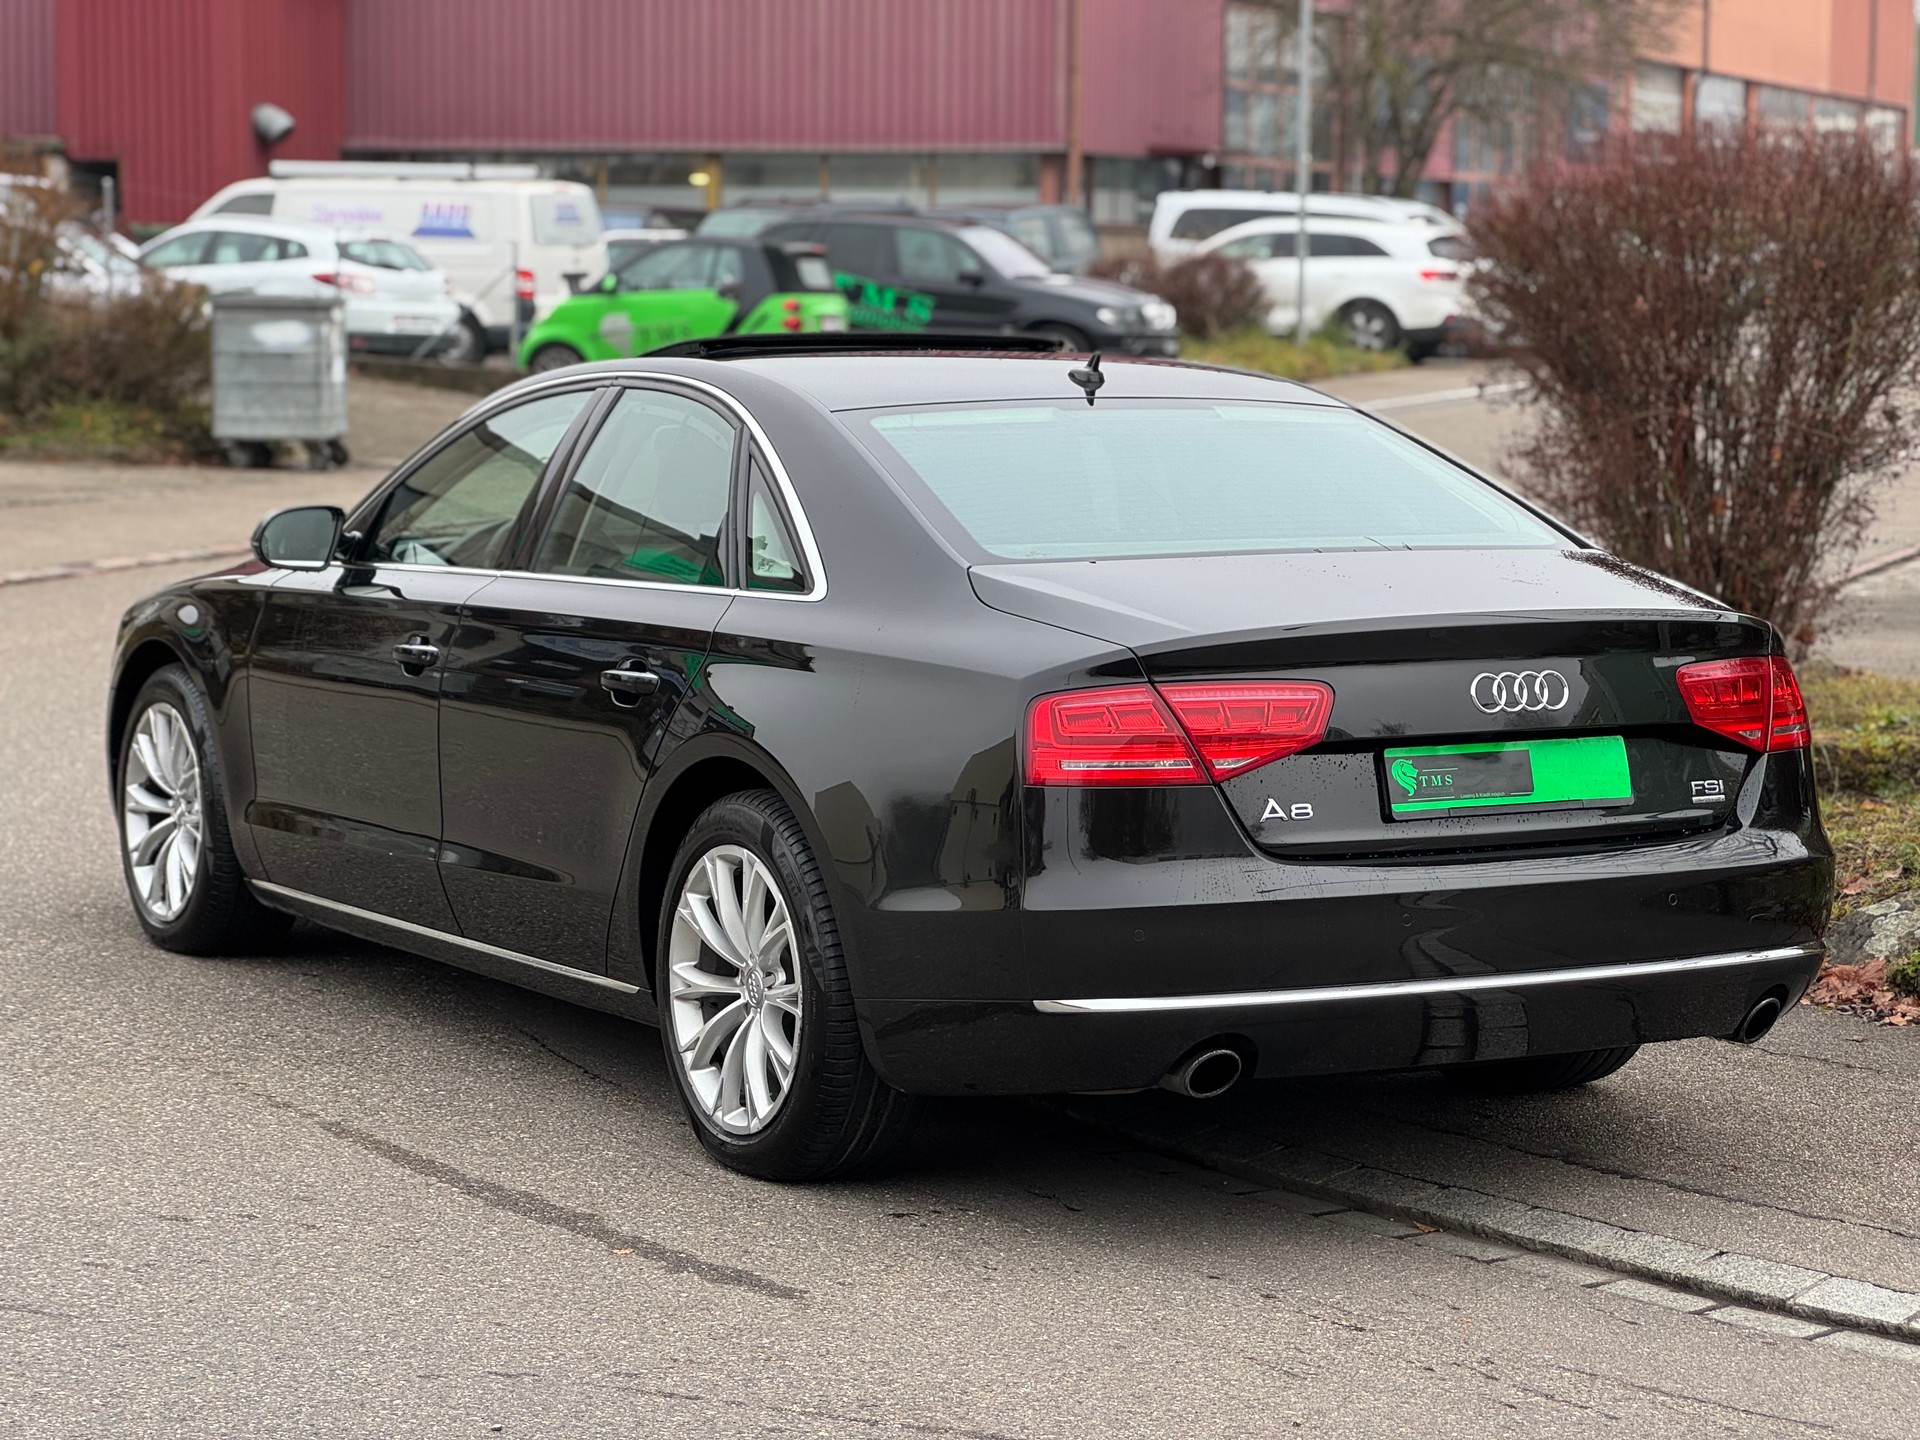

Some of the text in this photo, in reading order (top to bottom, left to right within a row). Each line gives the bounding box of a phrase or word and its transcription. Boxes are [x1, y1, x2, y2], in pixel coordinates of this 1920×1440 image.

[1419, 774, 1453, 787] TMS
[1691, 780, 1725, 795] FSI
[1260, 798, 1314, 822] A8
